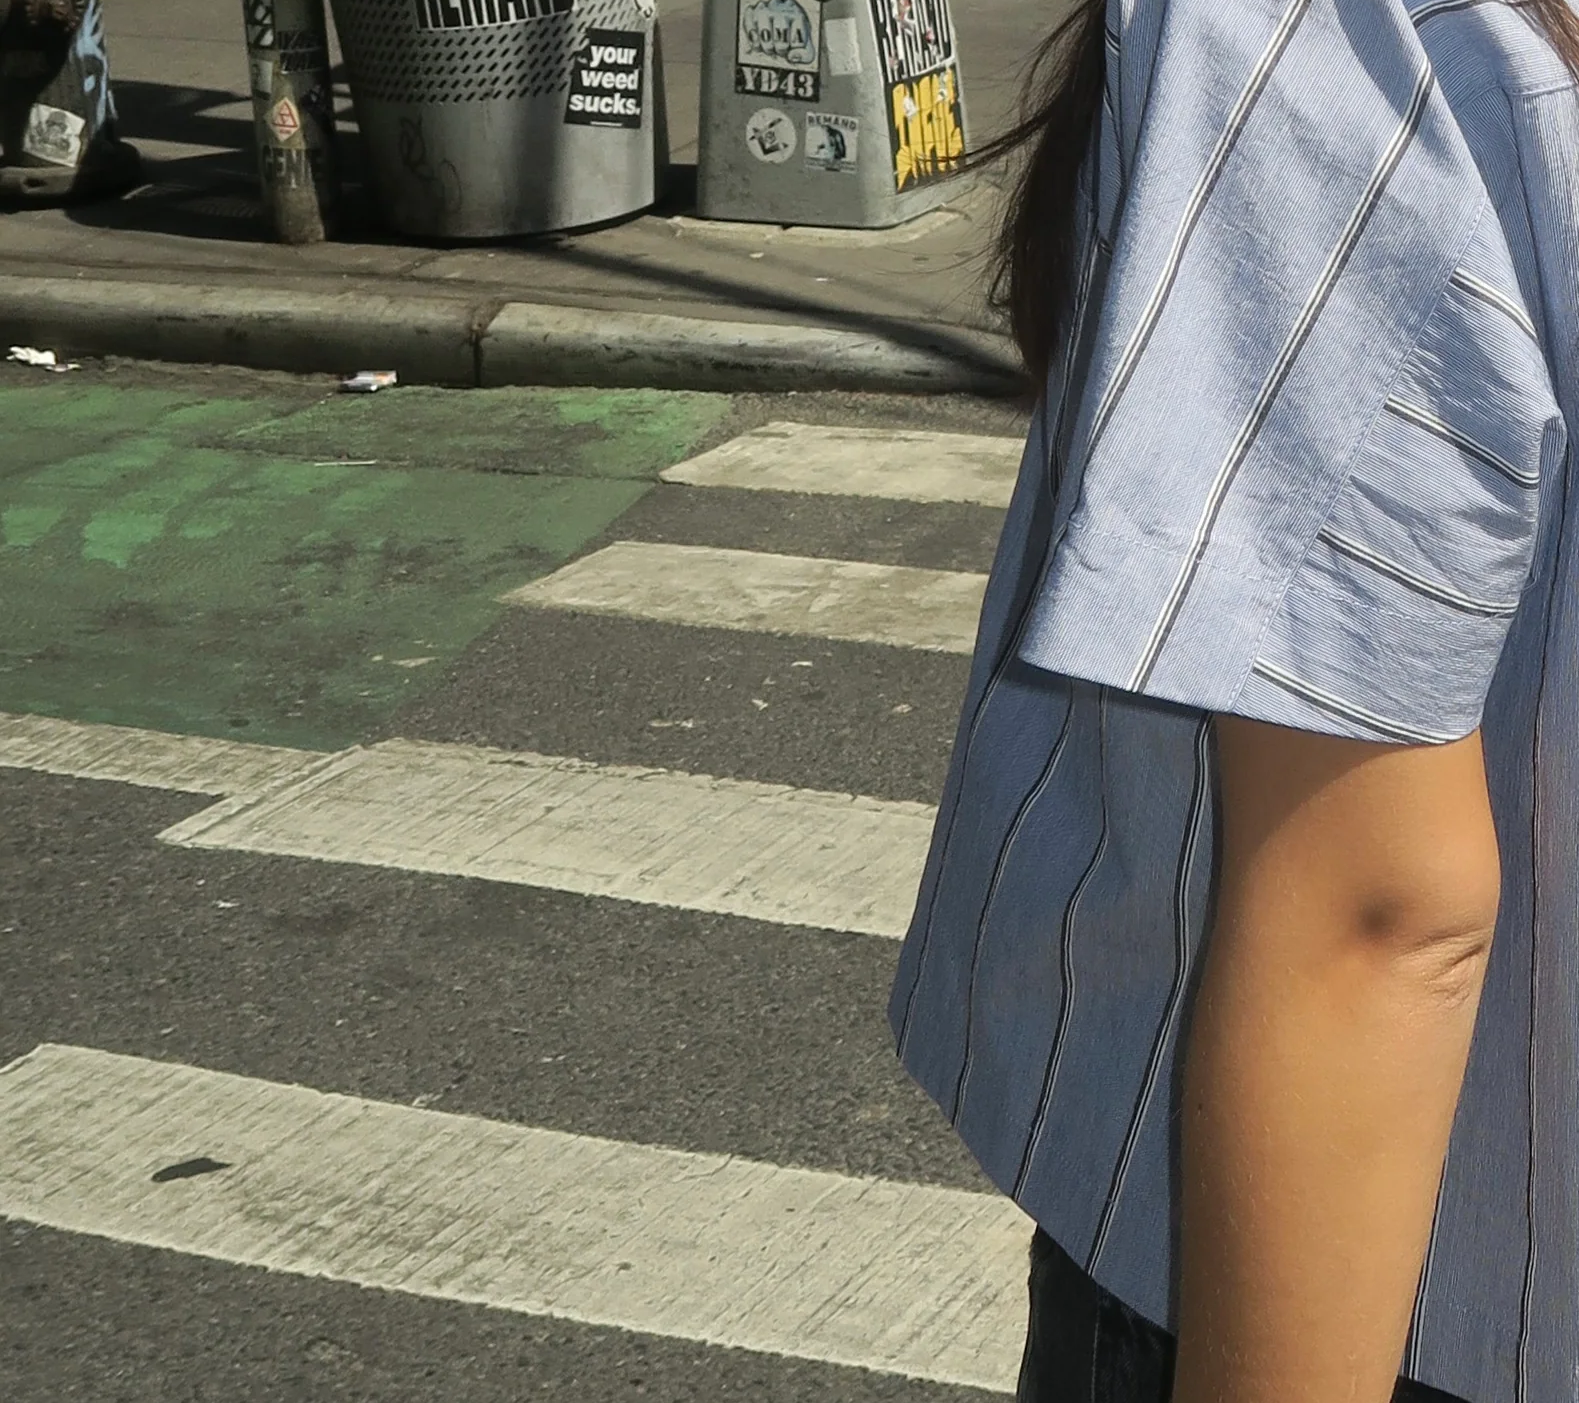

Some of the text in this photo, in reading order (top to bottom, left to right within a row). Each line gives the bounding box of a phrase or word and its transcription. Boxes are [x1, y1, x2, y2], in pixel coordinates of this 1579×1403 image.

[748, 26, 804, 45] COMA
[590, 45, 637, 67] your
[580, 68, 639, 90] weed
[569, 93, 641, 115] sucks.
